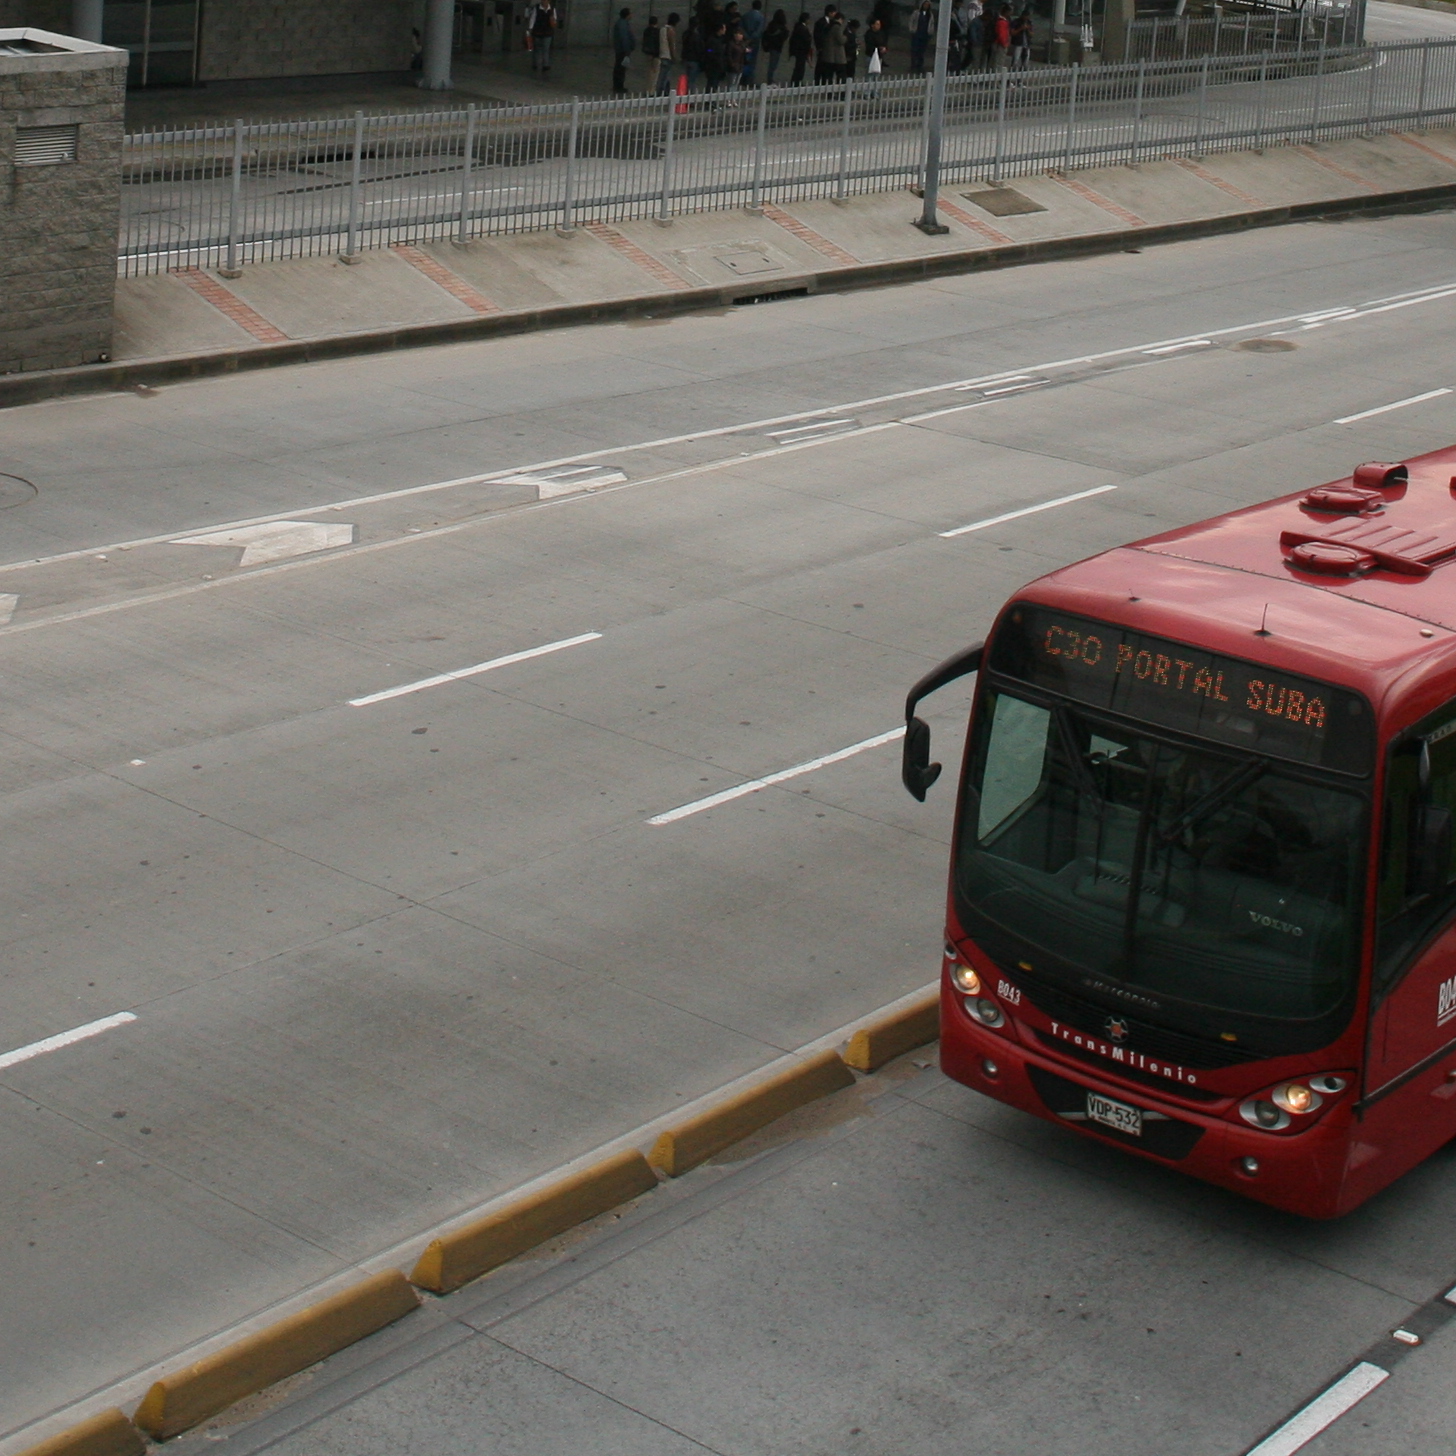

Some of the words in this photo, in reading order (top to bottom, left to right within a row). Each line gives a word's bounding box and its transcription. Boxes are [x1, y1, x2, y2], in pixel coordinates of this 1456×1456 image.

[1043, 624, 1104, 666] C30
[1115, 643, 1229, 702] PORTAL
[1246, 679, 1327, 728] SUBA
[1248, 910, 1304, 937] VOLVO
[997, 979, 1021, 1003] B043
[1050, 1021, 1198, 1085] TransMilenio
